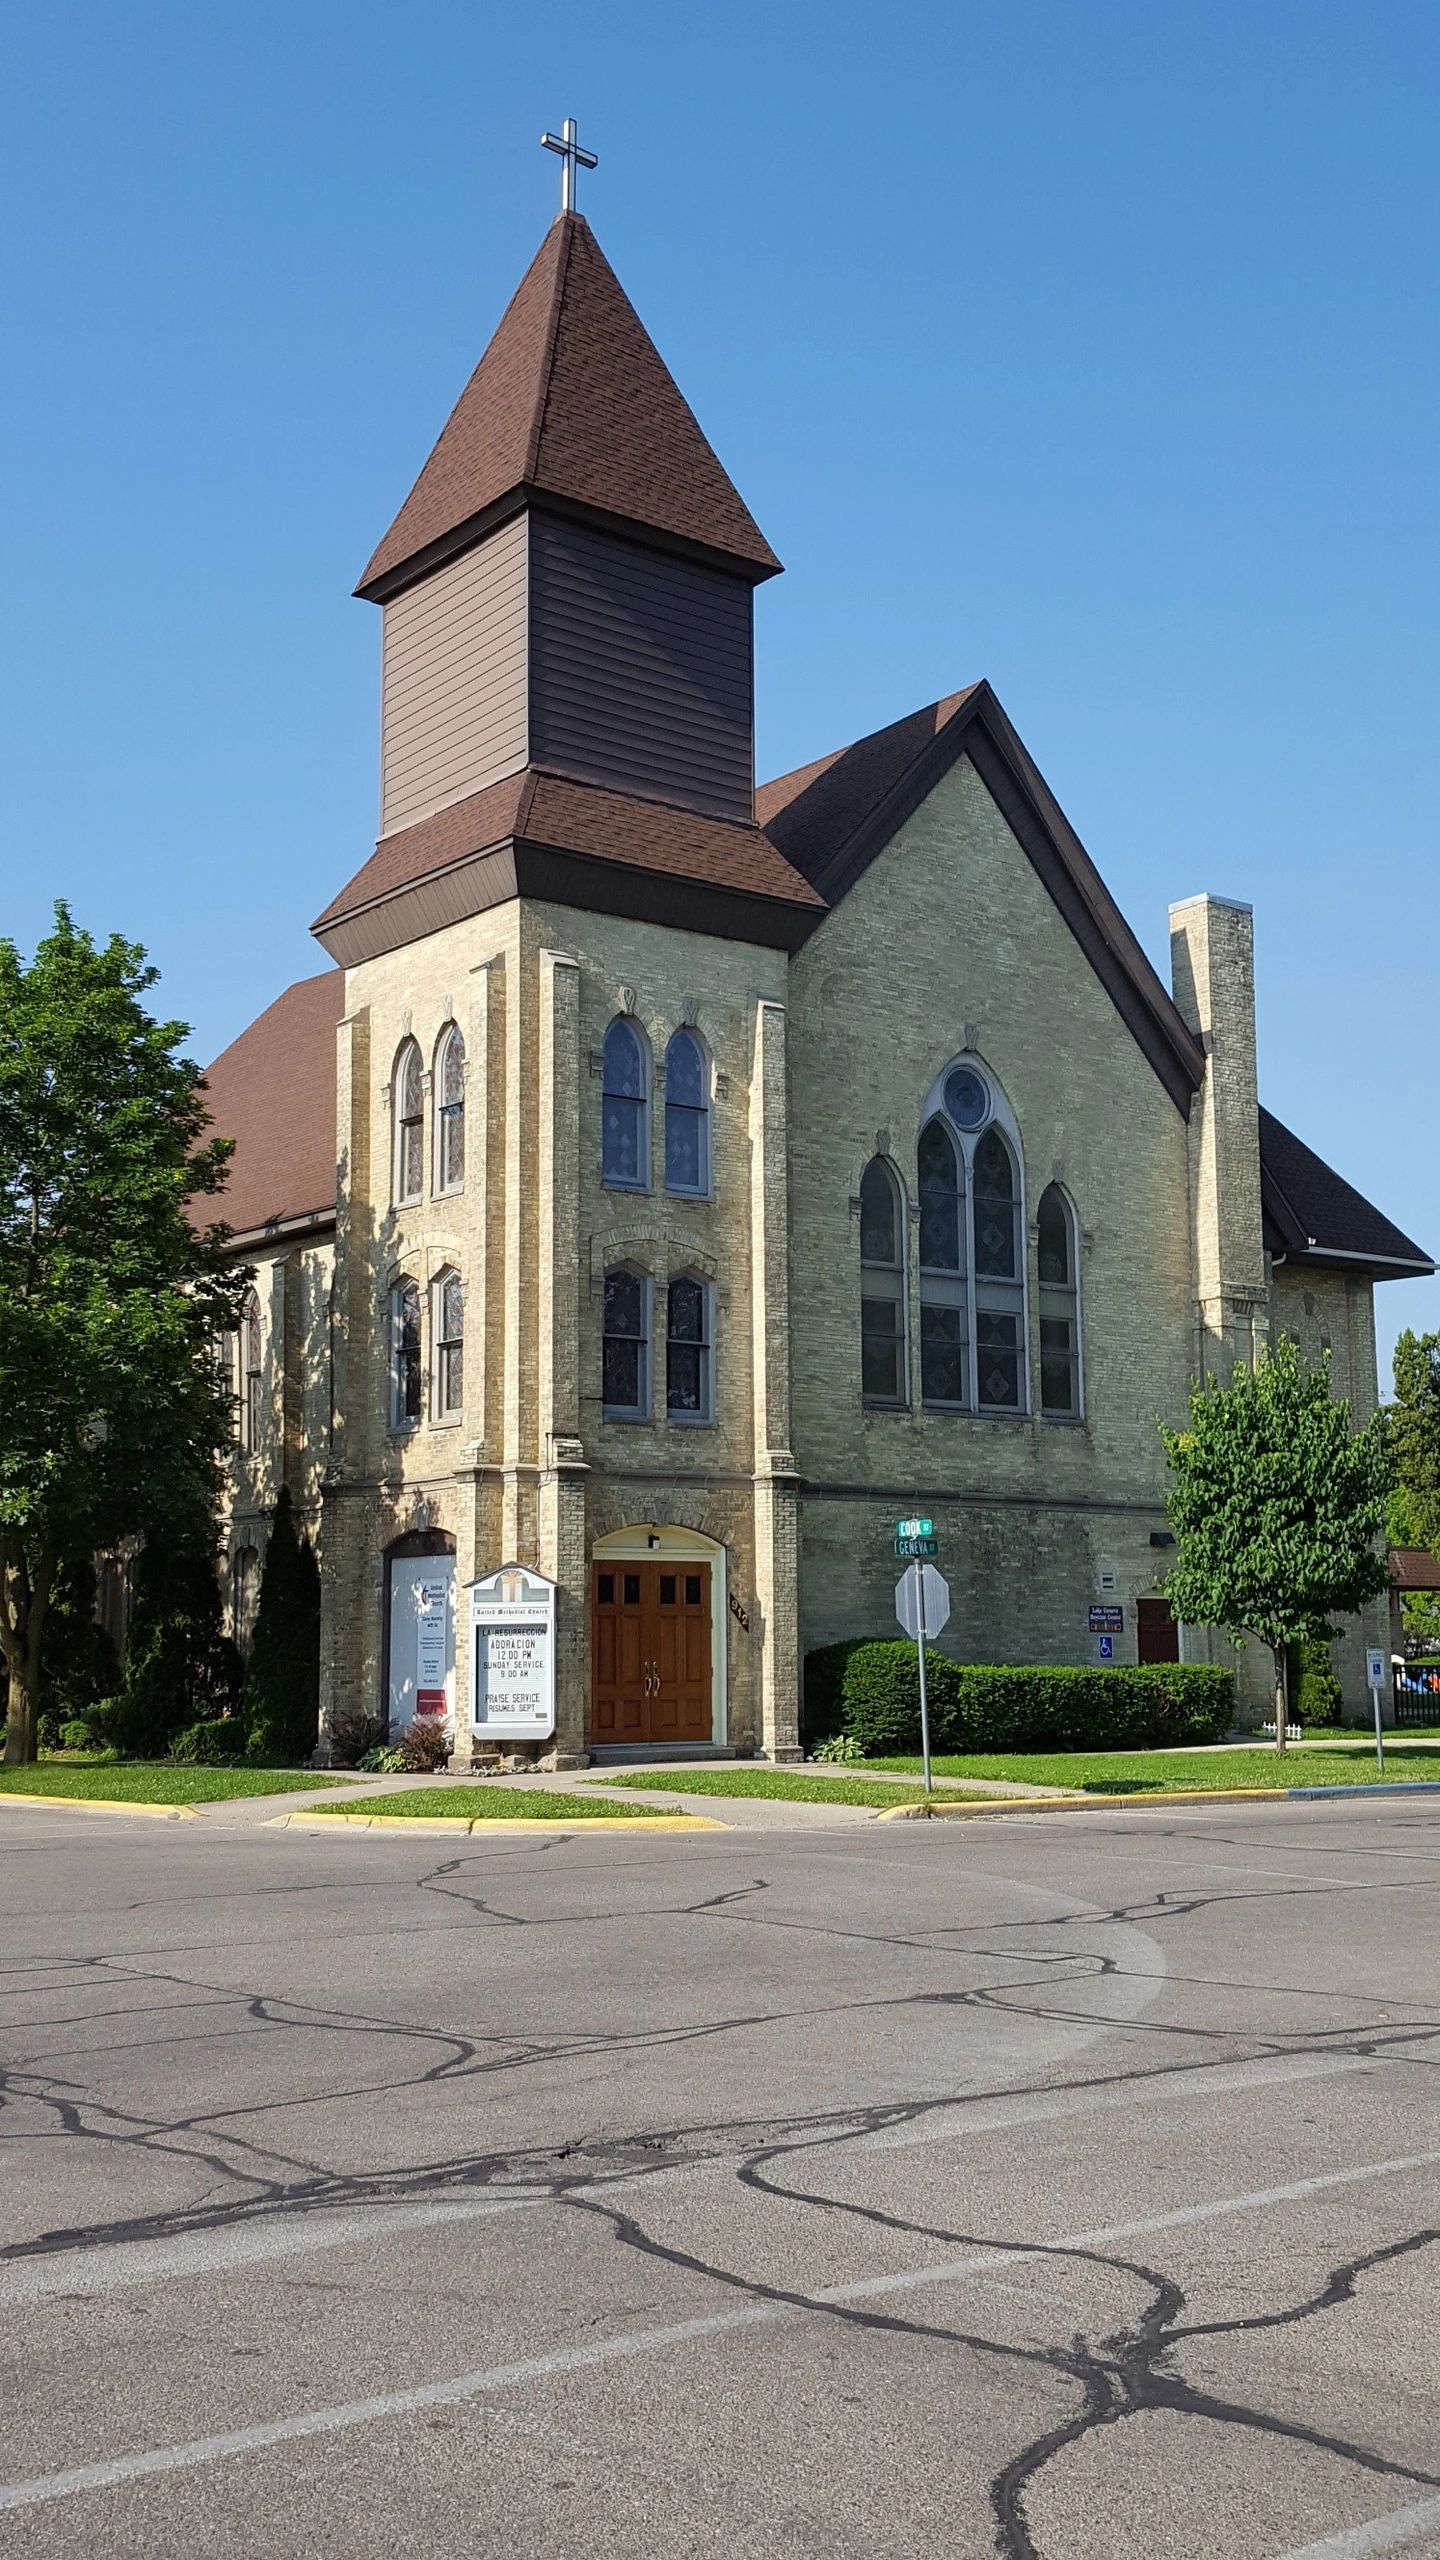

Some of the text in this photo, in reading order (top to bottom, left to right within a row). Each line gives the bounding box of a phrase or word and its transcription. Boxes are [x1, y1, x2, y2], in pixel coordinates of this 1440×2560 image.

[900, 1520, 921, 1536] COOK
[899, 1540, 929, 1555] GENEVA
[731, 1600, 748, 1625] 912
[482, 1628, 547, 1637] LA RESURRECCION
[490, 1639, 536, 1649] ADORACION
[522, 1650, 532, 1660] PM
[483, 1660, 544, 1669] SUNDAY SERVICE
[485, 1693, 540, 1703] PRAISE SERVICE
[488, 1703, 536, 1712] RESUMES SEPT
